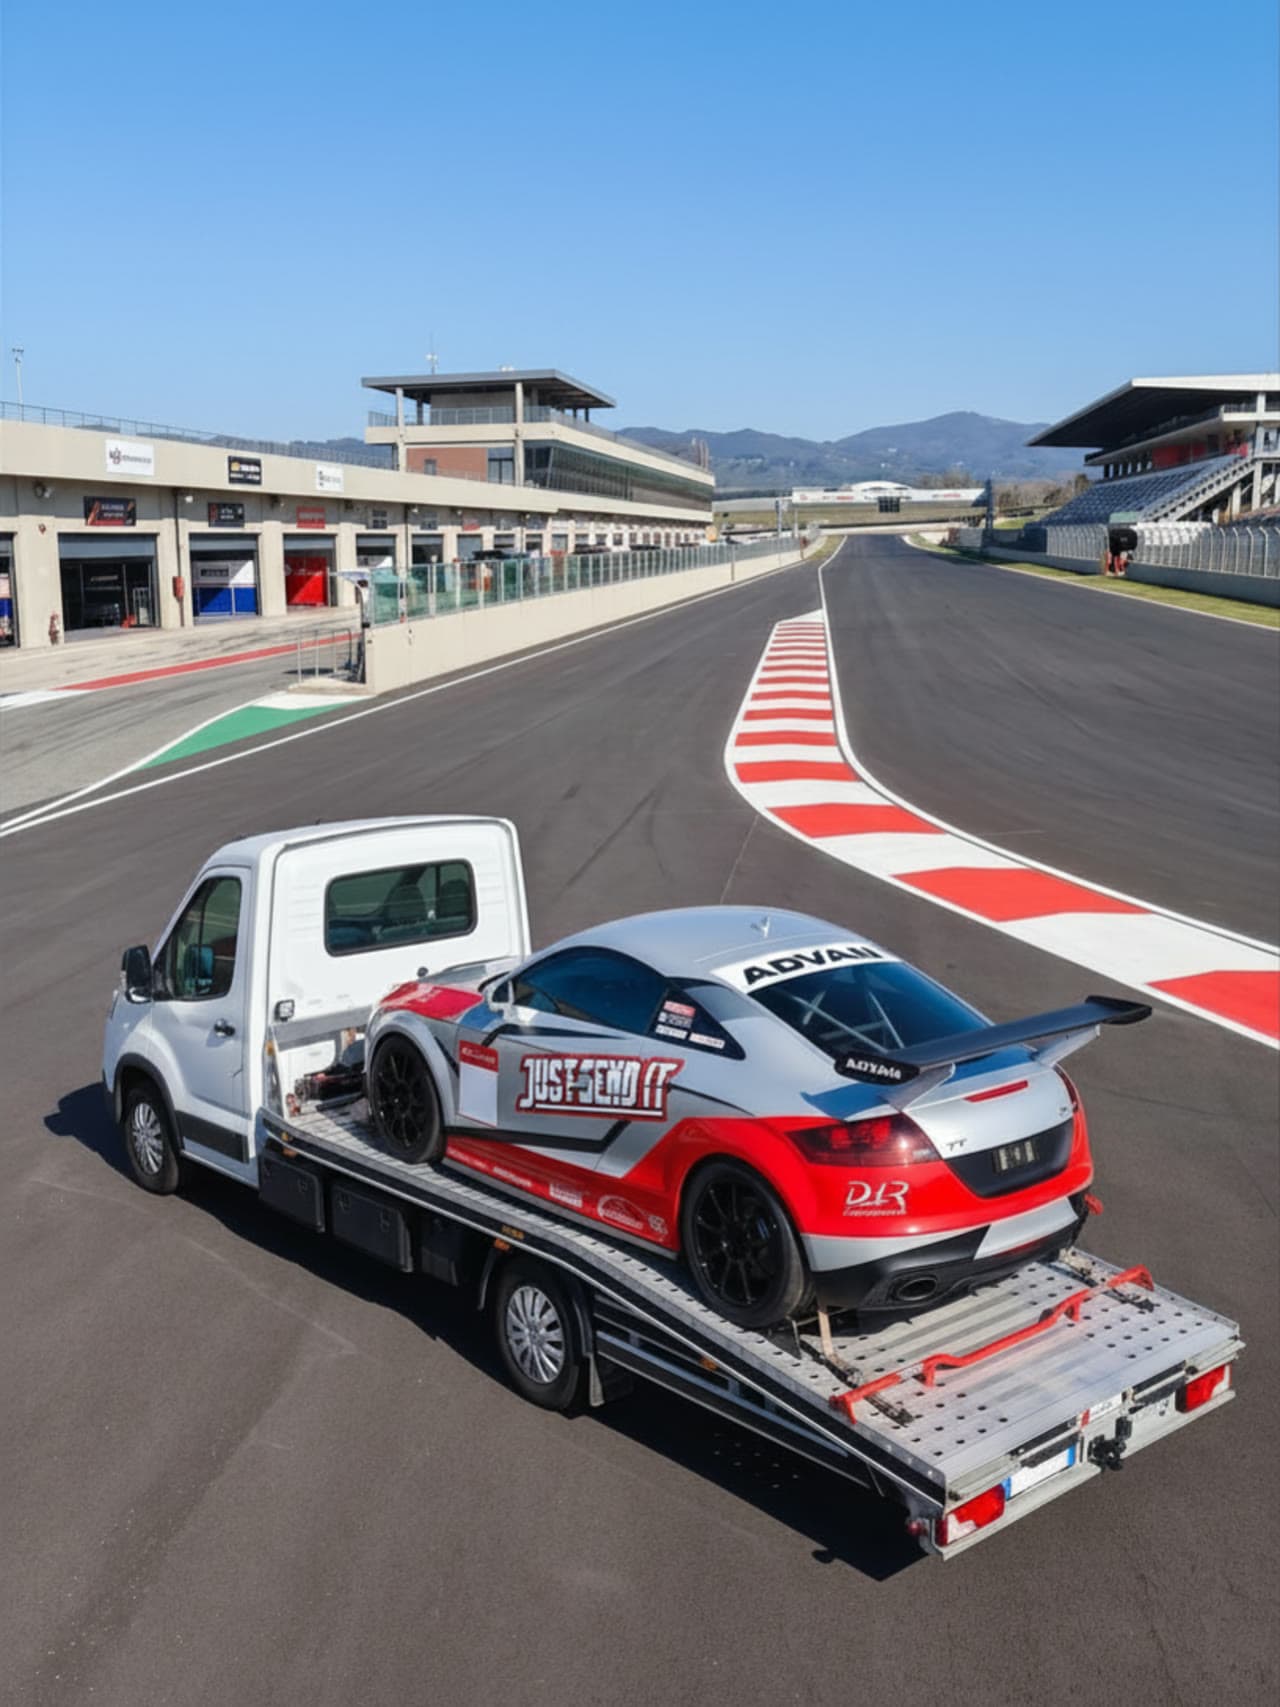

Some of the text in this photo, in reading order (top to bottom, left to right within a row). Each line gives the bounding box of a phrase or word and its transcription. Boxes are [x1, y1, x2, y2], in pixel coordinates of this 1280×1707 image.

[743, 946, 884, 985] ADVAN
[519, 1058, 577, 1108] JUST
[643, 1061, 678, 1109] IT
